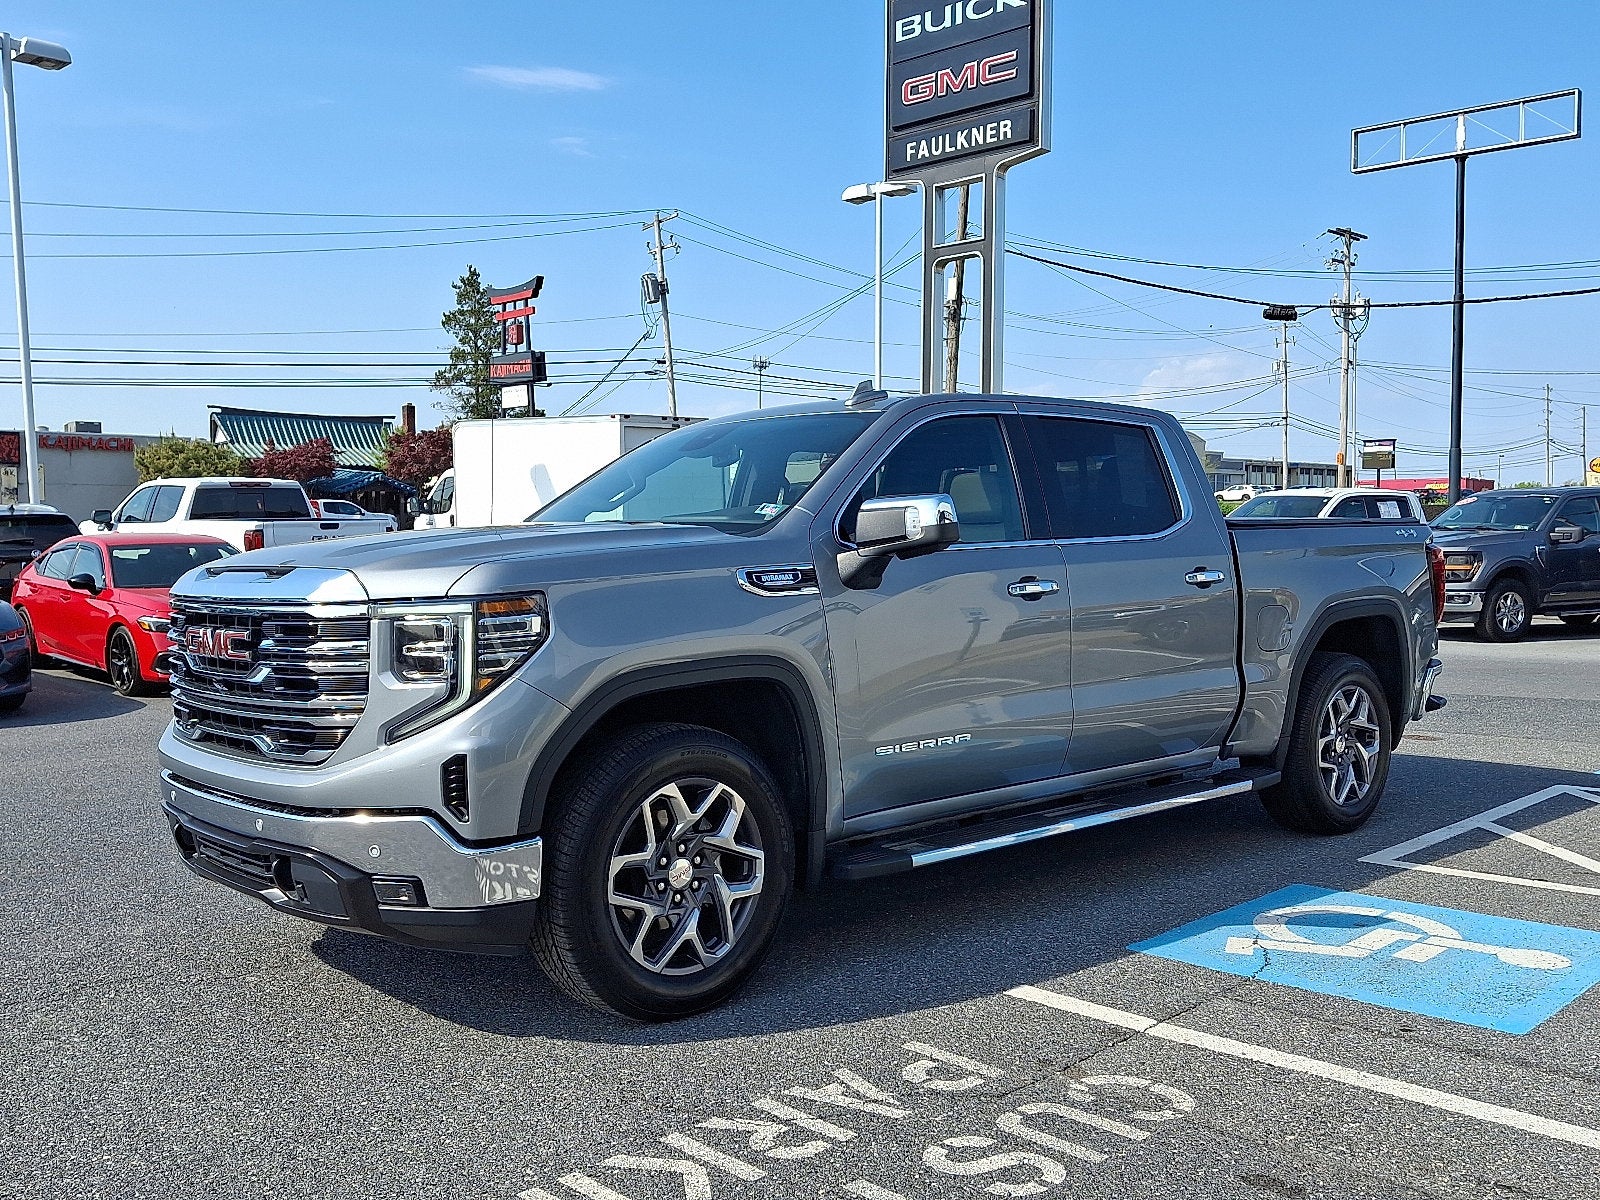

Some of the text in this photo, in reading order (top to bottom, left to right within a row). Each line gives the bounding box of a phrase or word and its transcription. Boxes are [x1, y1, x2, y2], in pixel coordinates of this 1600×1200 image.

[901, 49, 1019, 105] GMC
[906, 119, 1012, 162] FAULKNER
[490, 358, 531, 378] KAJIMACHI
[761, 573, 794, 582] DURAMAX
[186, 627, 253, 661] GMC
[875, 733, 972, 757] SIERRA
